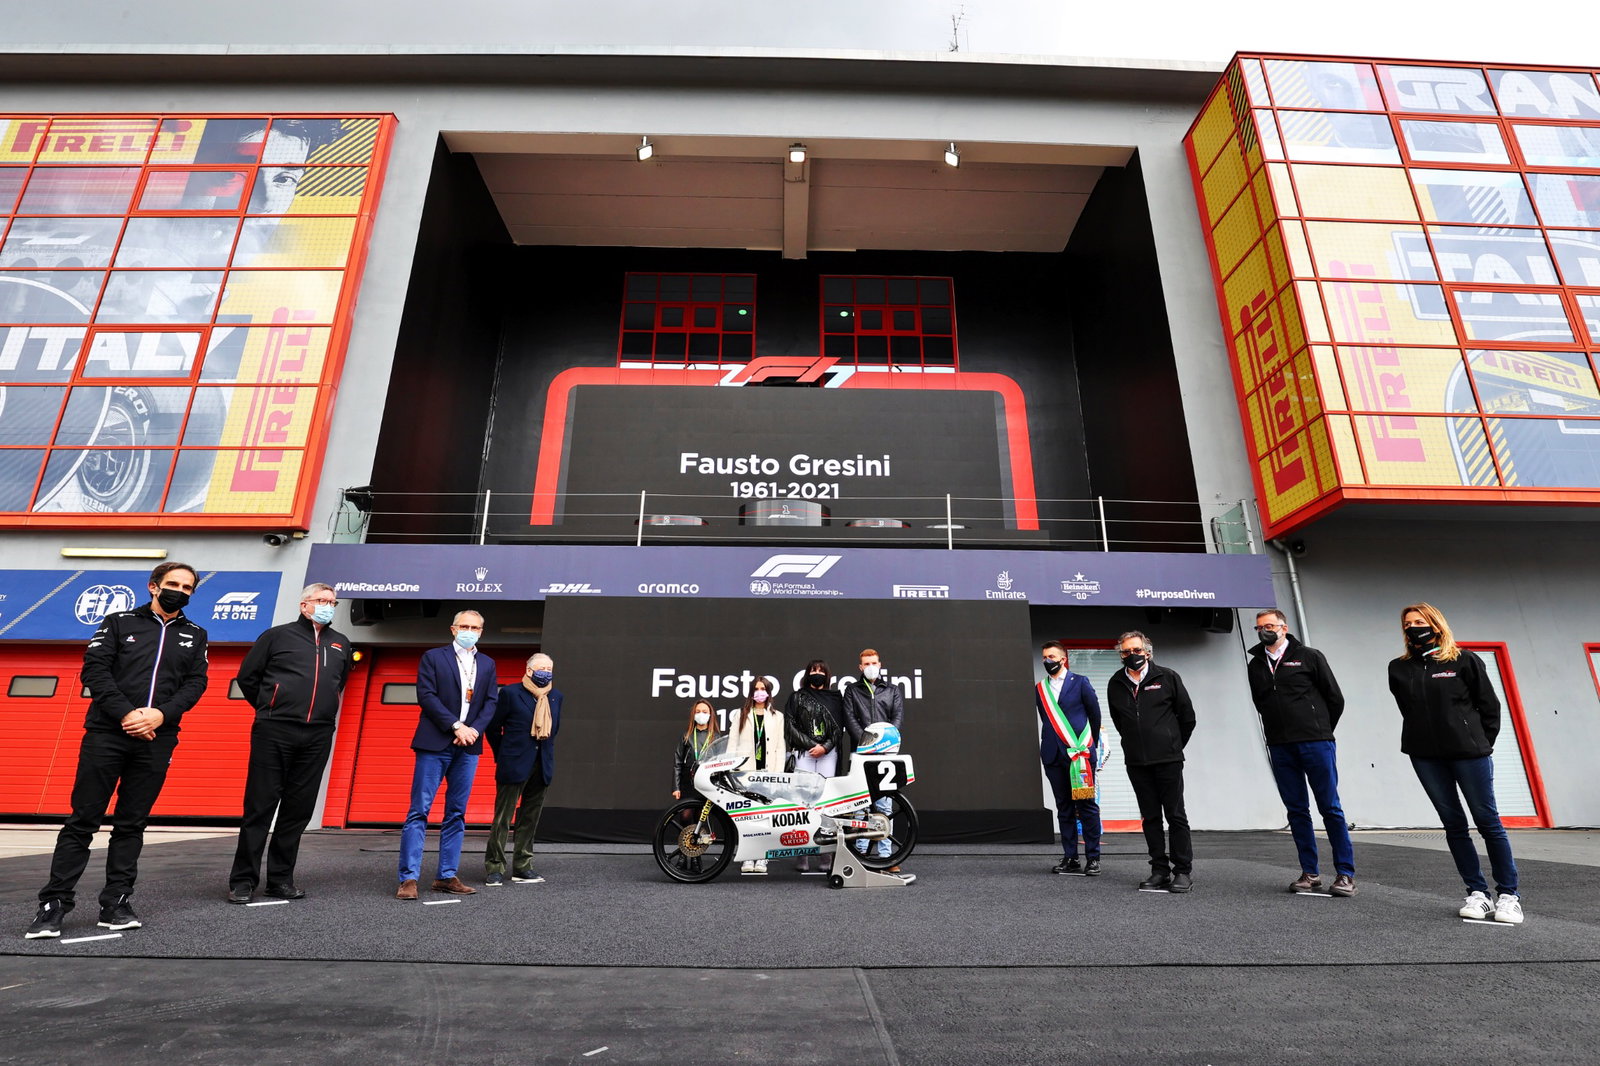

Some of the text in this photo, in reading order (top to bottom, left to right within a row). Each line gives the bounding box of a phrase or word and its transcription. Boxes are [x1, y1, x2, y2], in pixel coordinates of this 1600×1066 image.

[10, 120, 193, 153] PIRELLI
[1327, 259, 1427, 462] PIRELLI
[1482, 350, 1582, 389] PIRELLI
[1240, 289, 1306, 496] PIRELLI
[229, 306, 317, 492] PIRELLI
[679, 453, 891, 477] Fausto Gresini
[730, 482, 840, 499] 1961-2021
[334, 581, 420, 593] #WeRaceAsOne
[455, 583, 503, 594] ROLEX
[539, 583, 602, 594] DHL
[638, 583, 700, 594] aramco
[893, 584, 950, 599] PIRELLI
[1063, 583, 1099, 591] Heineken
[985, 589, 1027, 599] Emirates
[1135, 588, 1216, 600] #PurposeDriven
[231, 604, 258, 612] RACE
[211, 612, 257, 621] AS ONE
[747, 775, 791, 784] GARELLI
[877, 760, 898, 792] 2
[725, 799, 752, 811] MDS
[771, 811, 811, 828] KODAK
[781, 831, 808, 841] STELLA
[782, 837, 809, 846] ARTOIS
